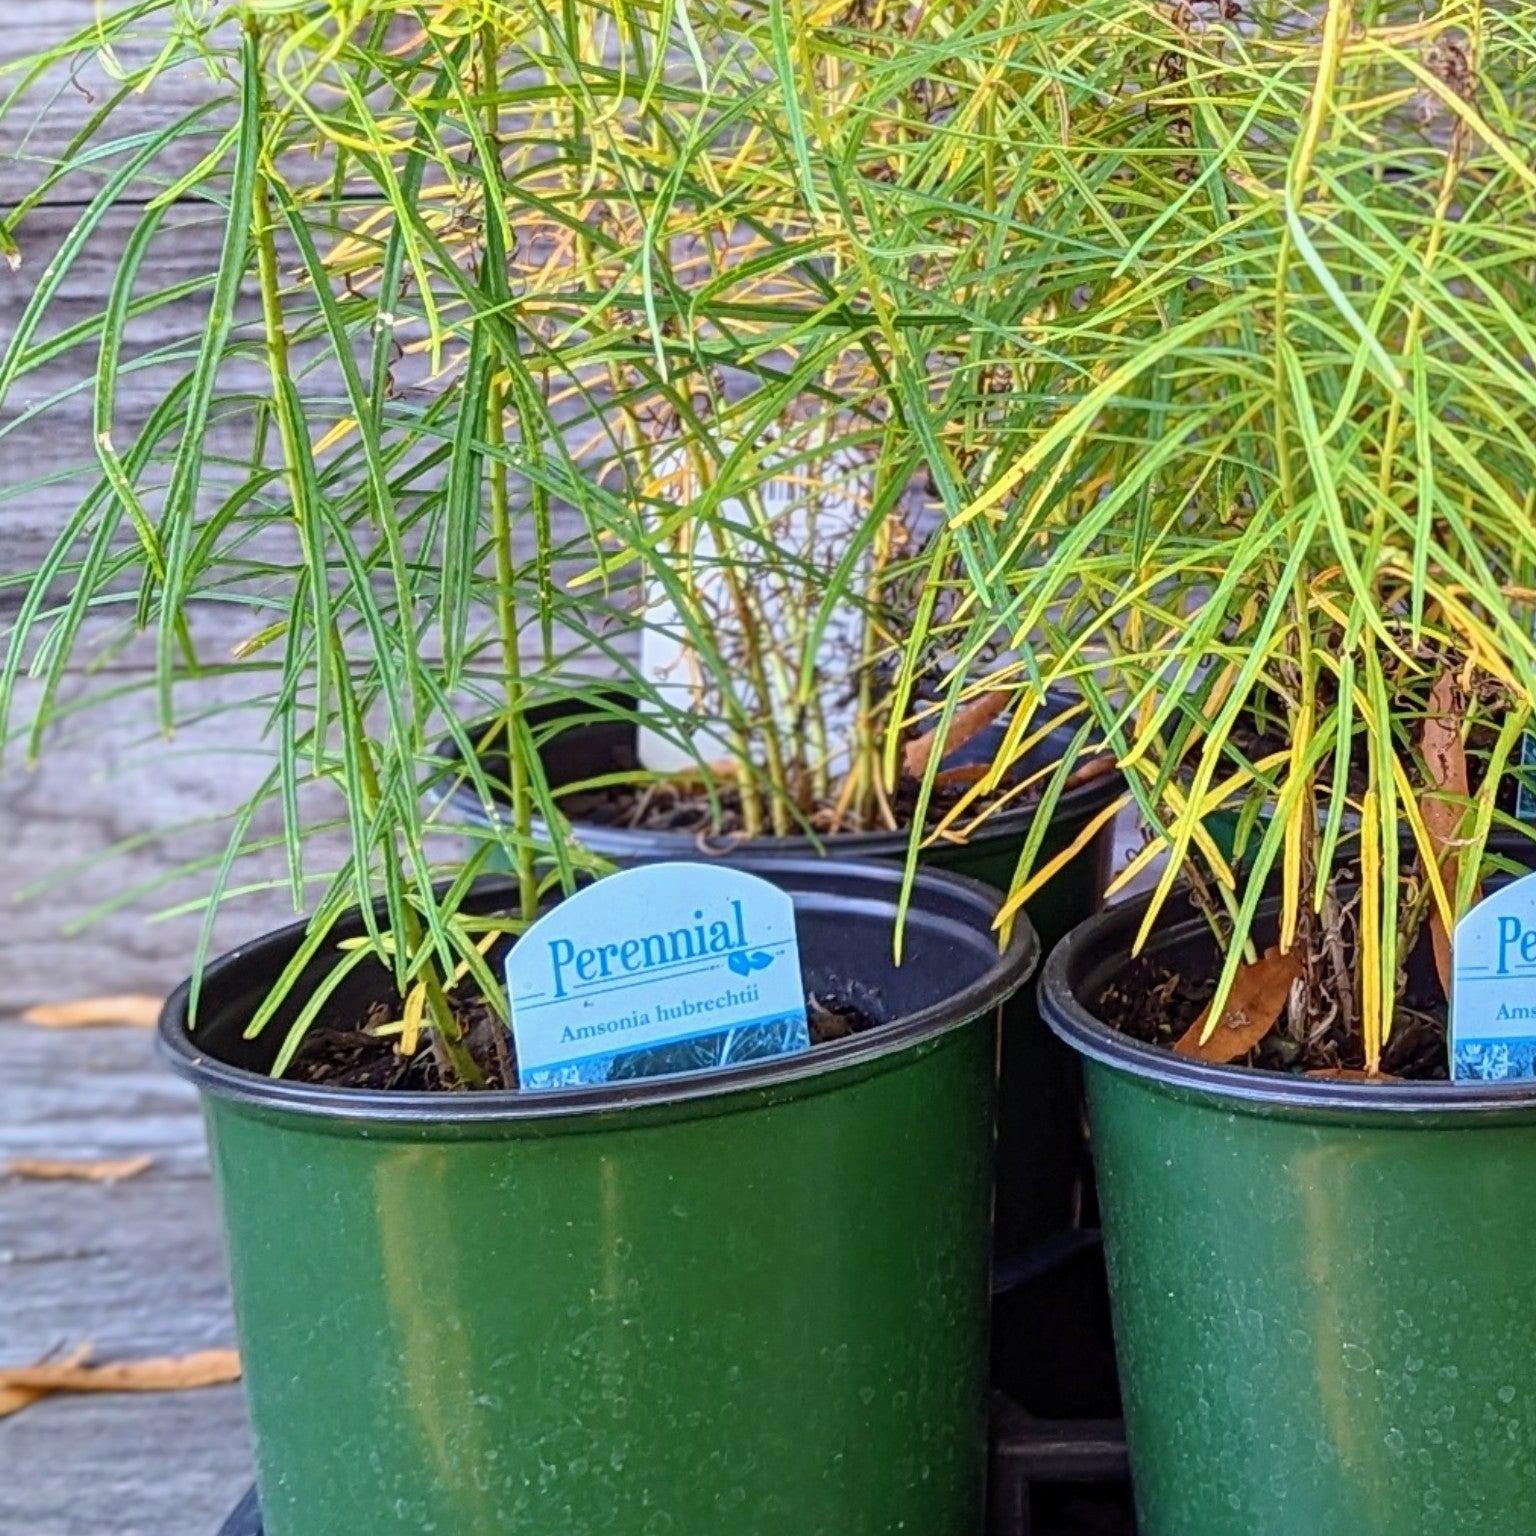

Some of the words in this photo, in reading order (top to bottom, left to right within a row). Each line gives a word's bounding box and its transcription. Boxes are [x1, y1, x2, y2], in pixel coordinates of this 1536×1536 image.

[548, 900, 748, 998] Perennial
[560, 1006, 651, 1043] Amsonia
[655, 984, 760, 1022] hubrechtii
